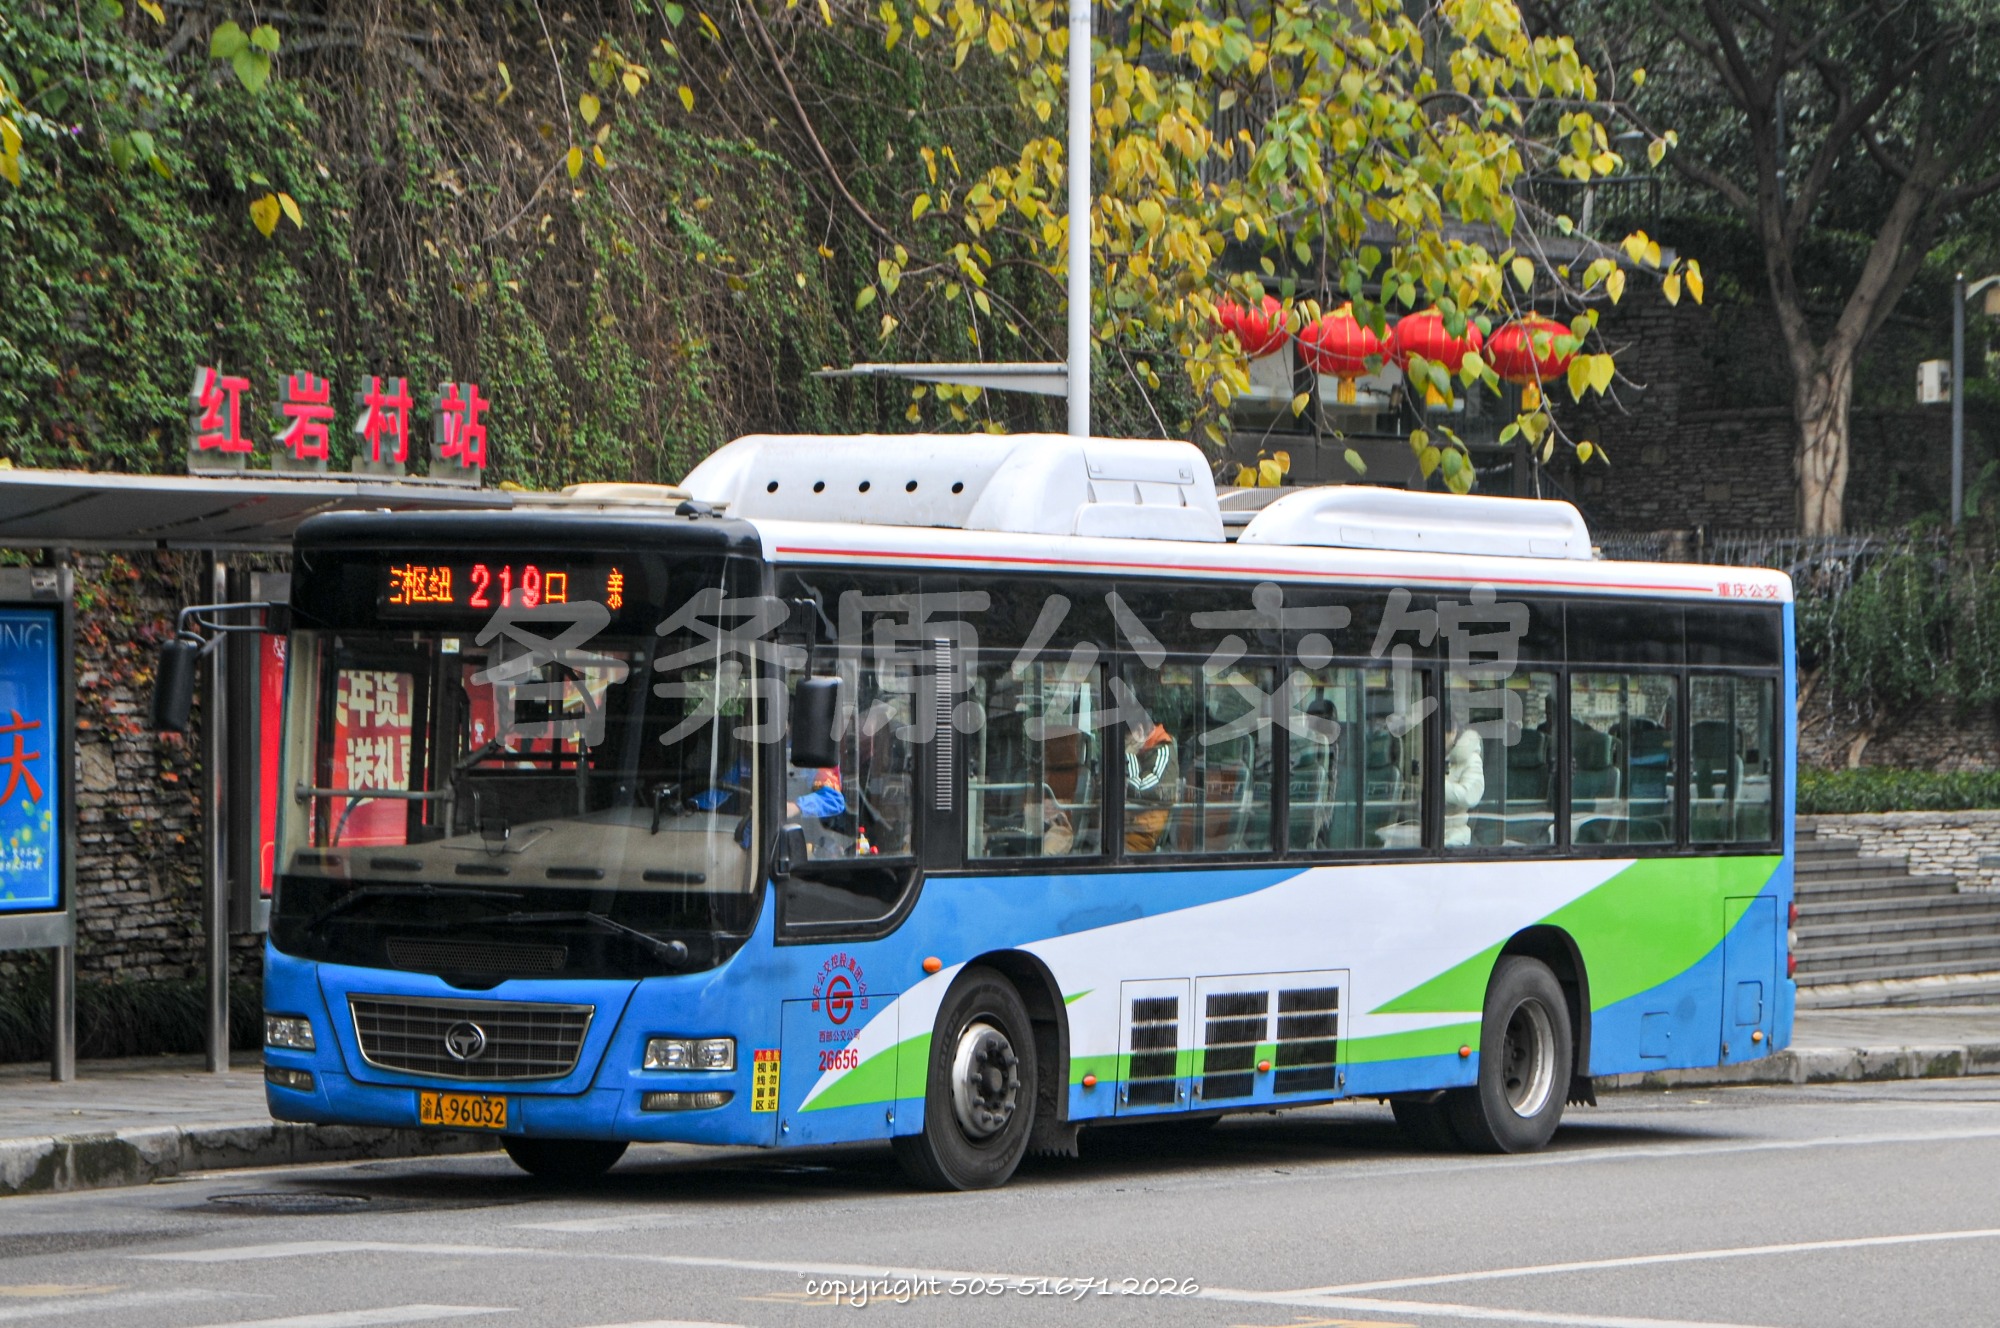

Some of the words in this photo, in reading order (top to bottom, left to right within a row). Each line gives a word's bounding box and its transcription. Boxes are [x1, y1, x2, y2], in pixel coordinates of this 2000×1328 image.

[196, 367, 489, 469] 红岩村站
[470, 564, 541, 608] 219
[1717, 582, 1779, 599] 重庆公交
[818, 1049, 858, 1071] 26656
